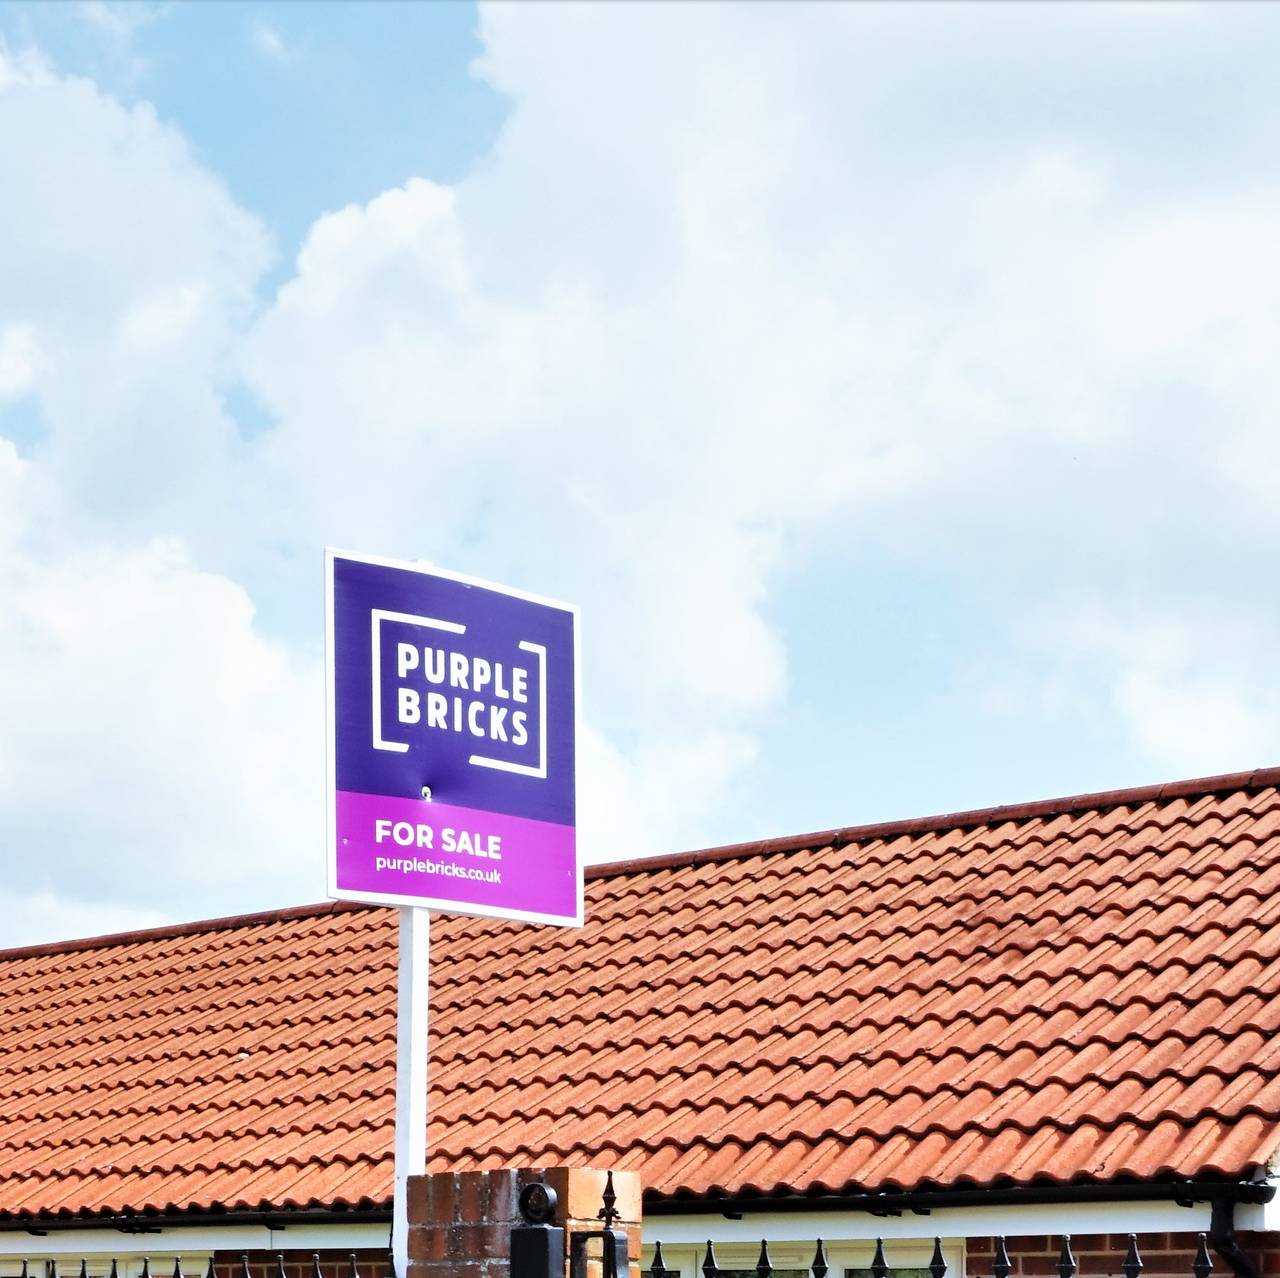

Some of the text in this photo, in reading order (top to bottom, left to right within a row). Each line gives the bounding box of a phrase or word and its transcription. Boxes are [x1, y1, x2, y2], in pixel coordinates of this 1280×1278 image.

[397, 642, 528, 704] PURPLE
[398, 687, 528, 746] BRICKS
[375, 819, 502, 860] FOR SALE
[376, 856, 502, 884] purplebricks.co.uk
